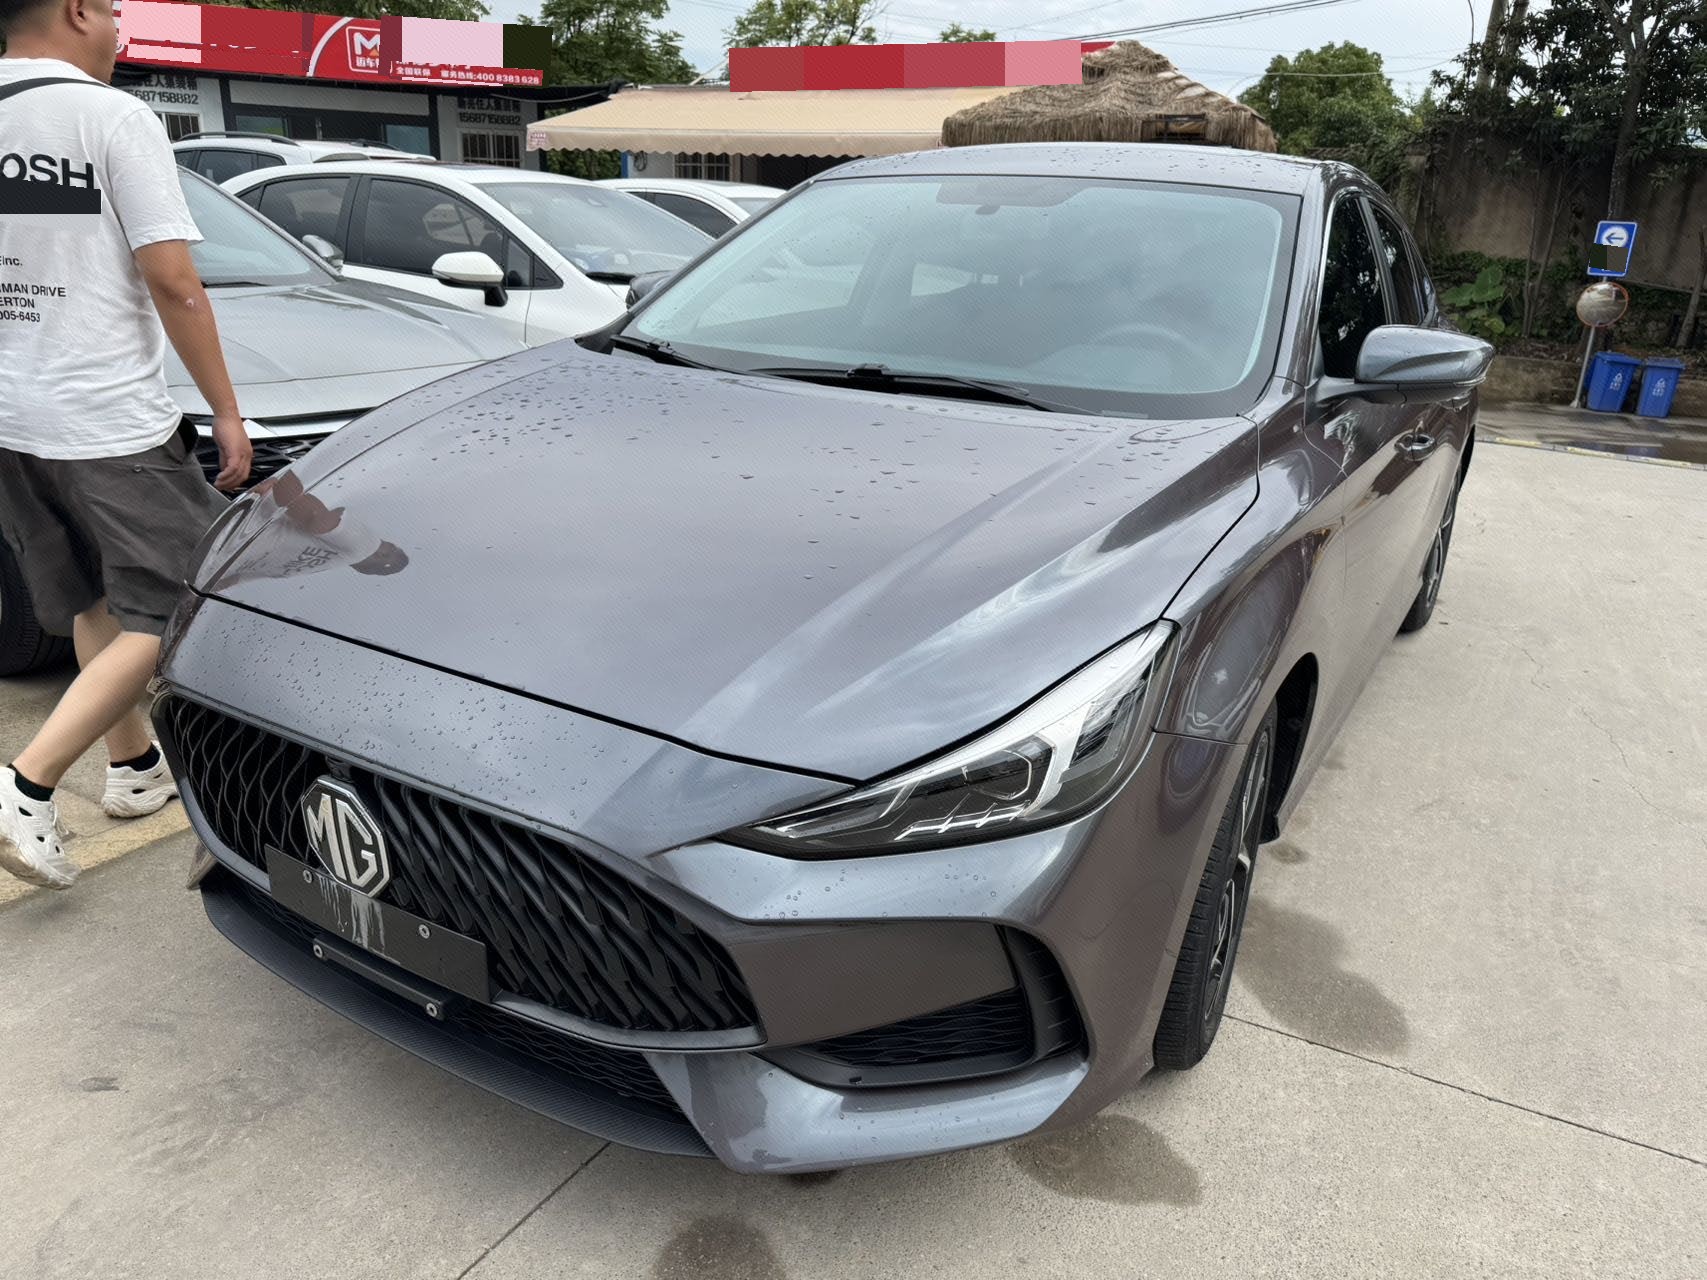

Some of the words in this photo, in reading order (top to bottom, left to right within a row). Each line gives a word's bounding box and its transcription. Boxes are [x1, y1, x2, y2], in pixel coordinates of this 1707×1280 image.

[396, 66, 432, 77] 全国联保
[521, 76, 541, 86] 628
[0, 153, 94, 189] OSH
[0, 282, 29, 295] MAN
[31, 284, 67, 298] DRIVE
[306, 792, 378, 888] MG
